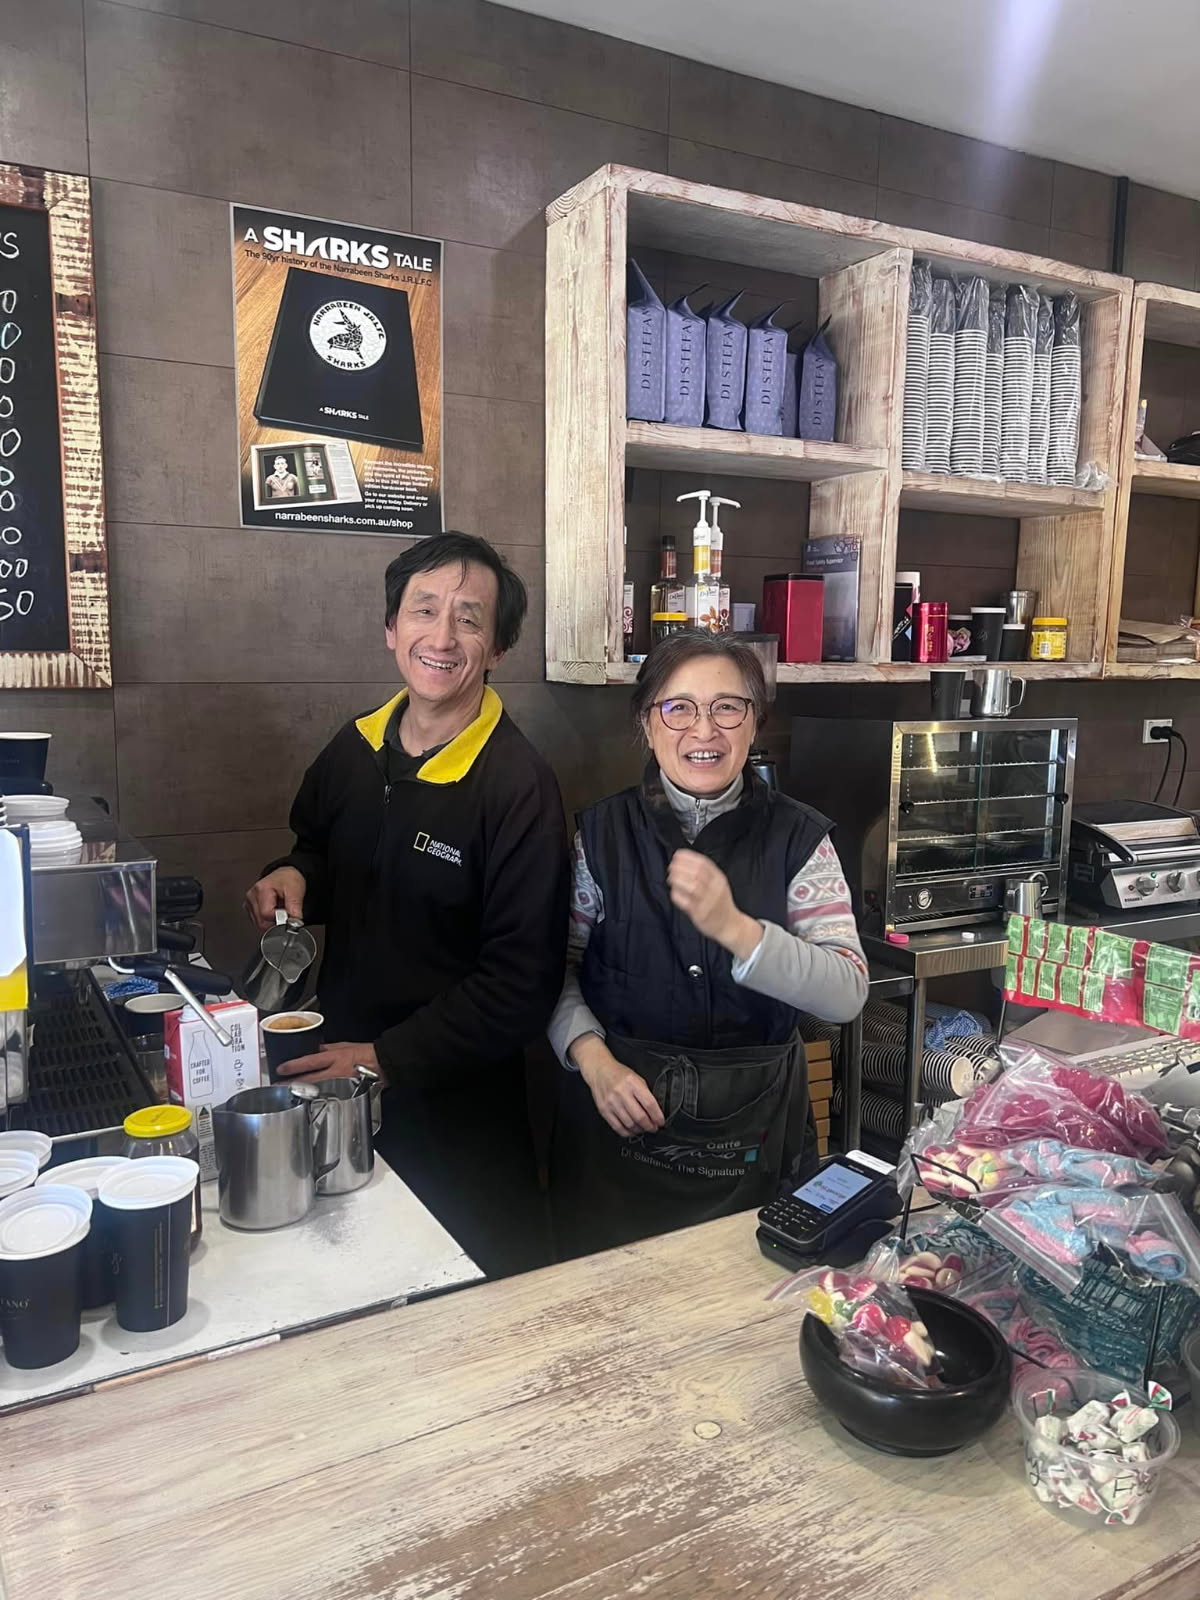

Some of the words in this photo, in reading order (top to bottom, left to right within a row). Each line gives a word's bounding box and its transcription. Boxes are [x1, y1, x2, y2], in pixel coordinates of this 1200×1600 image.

[244, 227, 260, 243] A
[263, 226, 390, 269] SHARKS
[393, 252, 433, 272] TALE
[244, 249, 261, 261] The
[261, 251, 280, 264] 90yr
[281, 255, 308, 269] history
[310, 259, 319, 269] of
[319, 260, 332, 271] the
[333, 263, 374, 278] Narrabeen
[374, 270, 400, 283] Sharks
[326, 355, 367, 369] SHARKS
[324, 406, 358, 419] SHARKS
[275, 510, 413, 529] narrabeensharks.com.au/shop
[190, 1059, 210, 1069] CRAFTED
[196, 1068, 205, 1076] FOR
[192, 1074, 210, 1085] COFFEE
[677, 1164, 695, 1175] The
[697, 1166, 745, 1179] Signature
